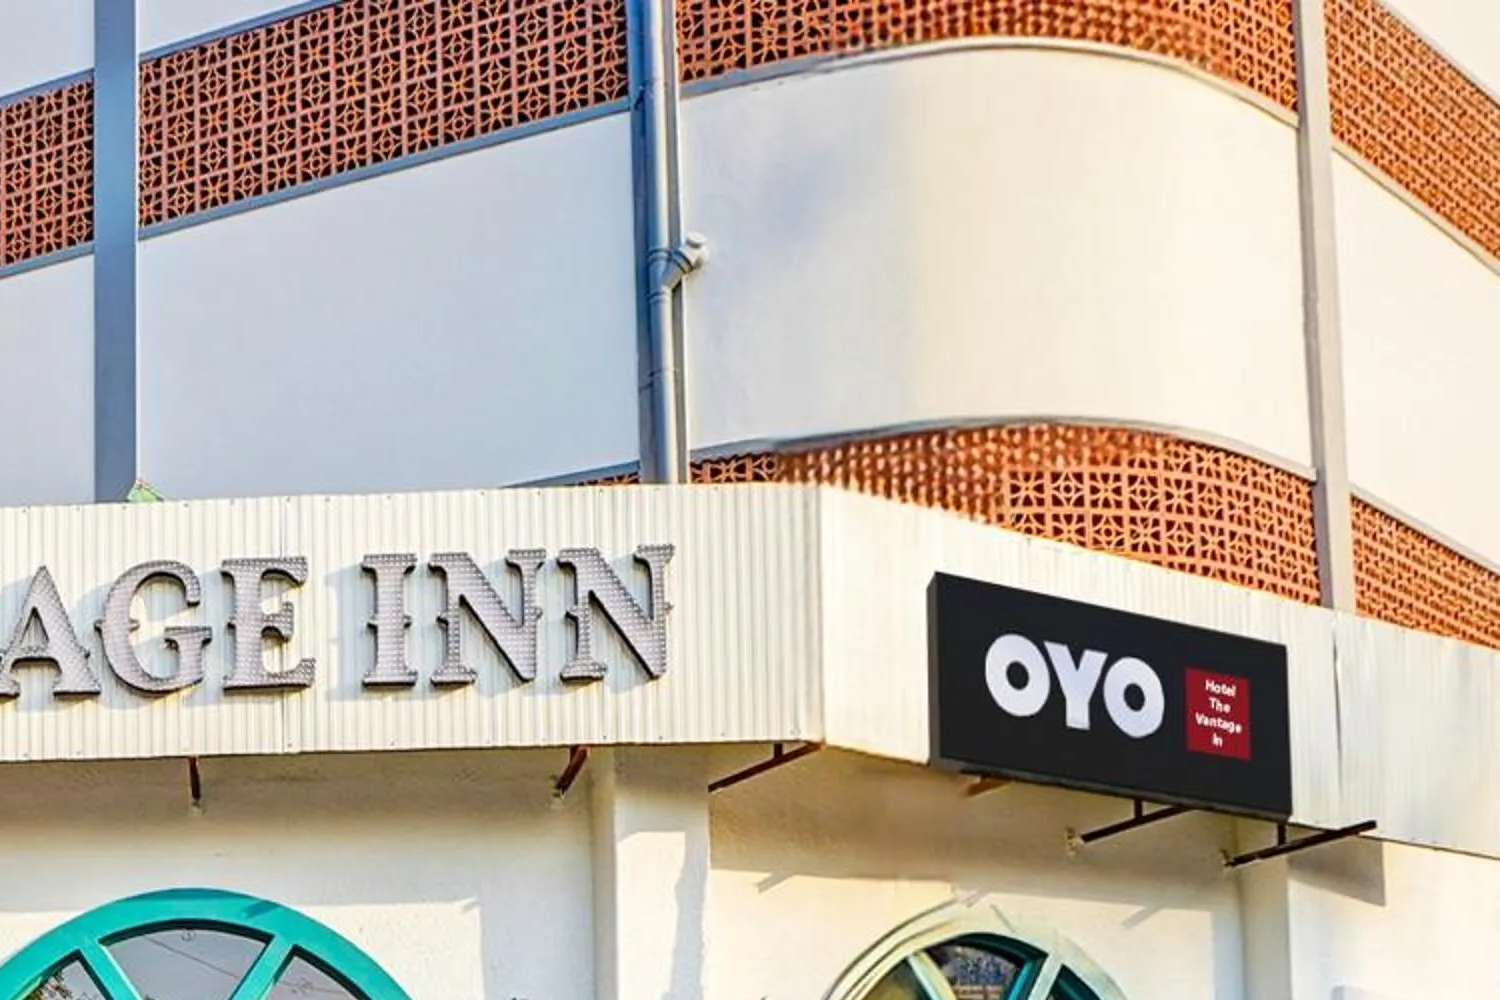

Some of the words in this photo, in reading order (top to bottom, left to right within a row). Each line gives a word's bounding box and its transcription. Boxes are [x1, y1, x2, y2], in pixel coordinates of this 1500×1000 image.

[361, 544, 676, 687] INN
[985, 633, 1165, 739] OYO
[1205, 679, 1236, 697] Hotel
[1208, 696, 1231, 713] The
[1195, 711, 1243, 734] Vantage
